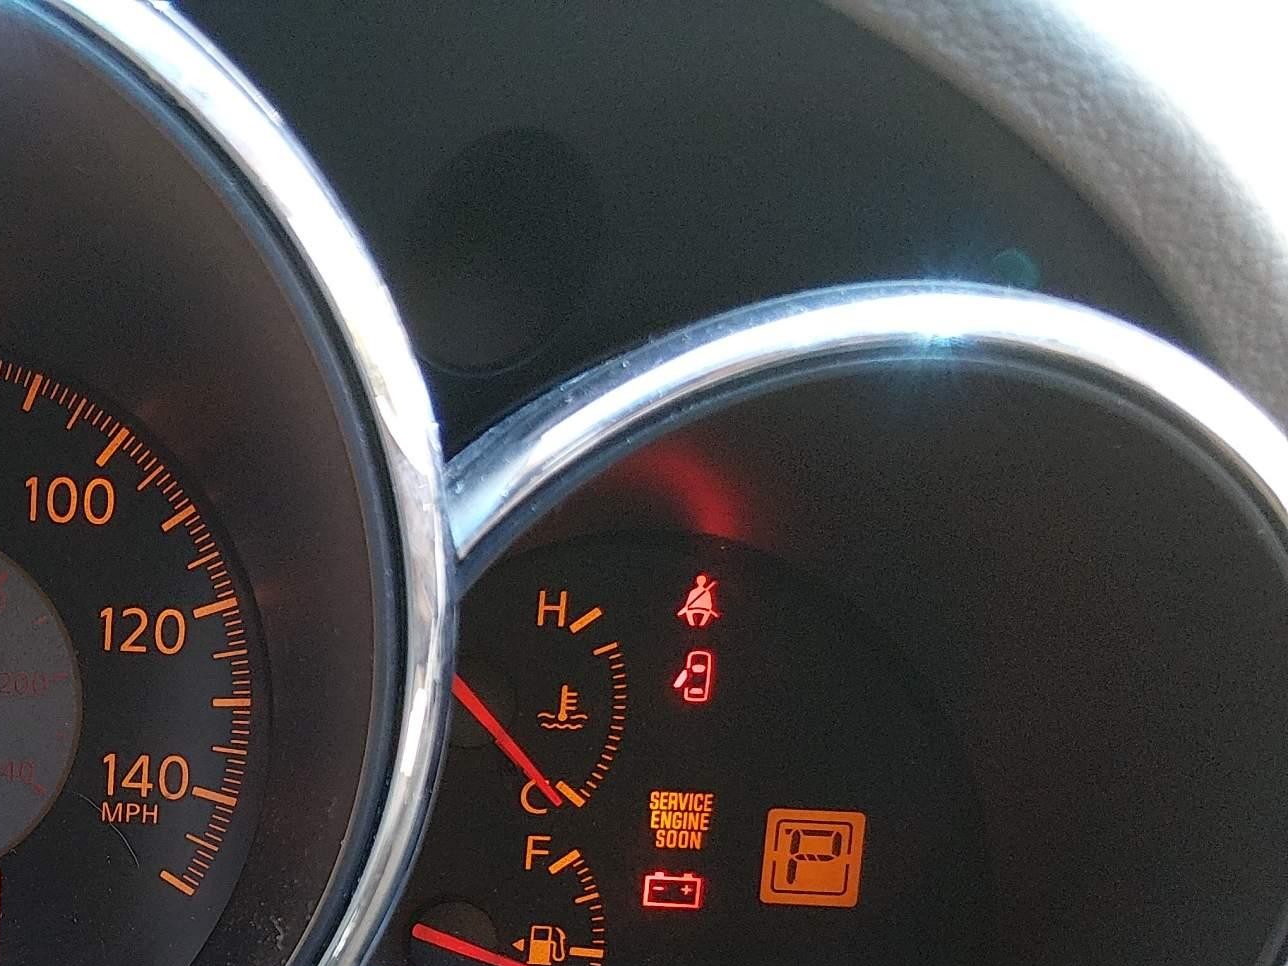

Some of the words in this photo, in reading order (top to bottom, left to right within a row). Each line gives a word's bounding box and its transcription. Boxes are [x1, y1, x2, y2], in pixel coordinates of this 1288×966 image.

[24, 476, 115, 525] 100
[537, 590, 567, 627] H
[99, 606, 186, 655] 120
[102, 753, 191, 800] 140
[101, 802, 159, 825] MPH
[520, 780, 549, 814] C
[649, 791, 714, 812] SERVICE
[650, 811, 709, 831] ENGINE
[525, 836, 550, 870] F
[655, 830, 701, 849] SOON
[784, 828, 842, 885] P
